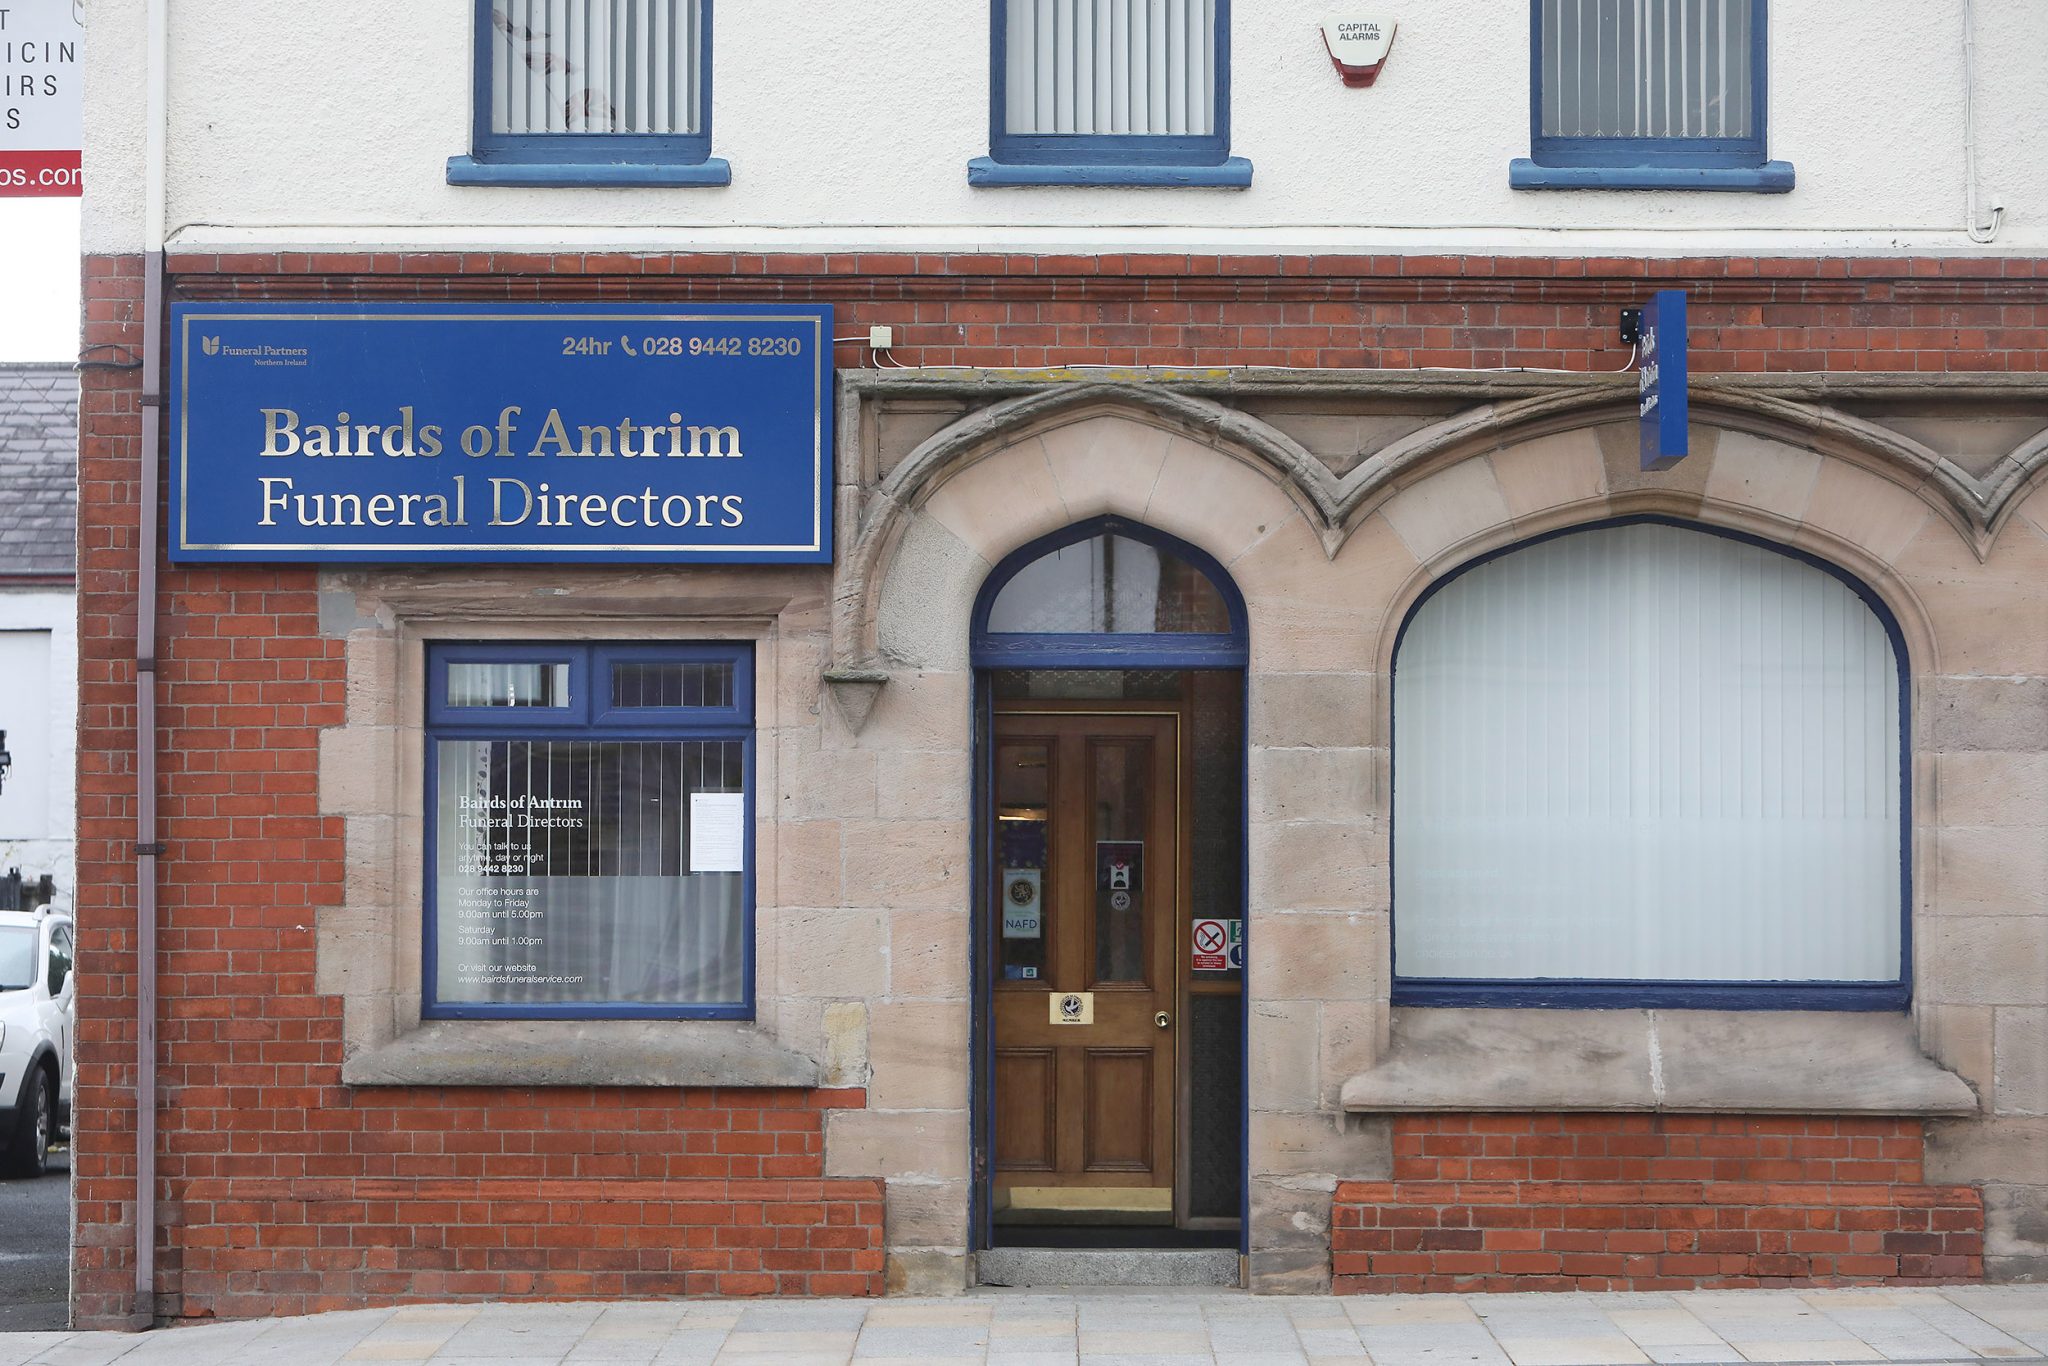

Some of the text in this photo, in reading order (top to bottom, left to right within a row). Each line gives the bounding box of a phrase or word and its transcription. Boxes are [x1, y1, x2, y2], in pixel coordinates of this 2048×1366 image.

[1338, 23, 1381, 32] CAPITAL
[1340, 33, 1380, 41] ALARMS
[222, 345, 308, 356] Funeral Partners
[562, 337, 801, 356] 24hr 028 9442 8230
[259, 405, 744, 457] Bairds of Antrim
[257, 475, 744, 527] Funeral Directors
[459, 795, 583, 809] Bairds of Antrim
[459, 814, 583, 828] Funeral Directors
[459, 842, 531, 851] You can talk to us
[495, 854, 510, 863] day
[459, 865, 524, 873] 028 9442 8230
[459, 888, 473, 896] Our
[476, 887, 498, 896] office
[500, 888, 524, 896] hours
[459, 899, 529, 909] Monday to Friday
[459, 910, 543, 920] 9.00am until 5.00pm
[1005, 919, 1037, 929] NAFD
[459, 926, 495, 936] Saturday
[459, 937, 543, 947] 9.00am until 1.00pm
[459, 964, 470, 972] Or
[471, 964, 486, 972] visit
[504, 964, 536, 972] website
[458, 974, 583, 984] www.bairdsfuneralservice.com
